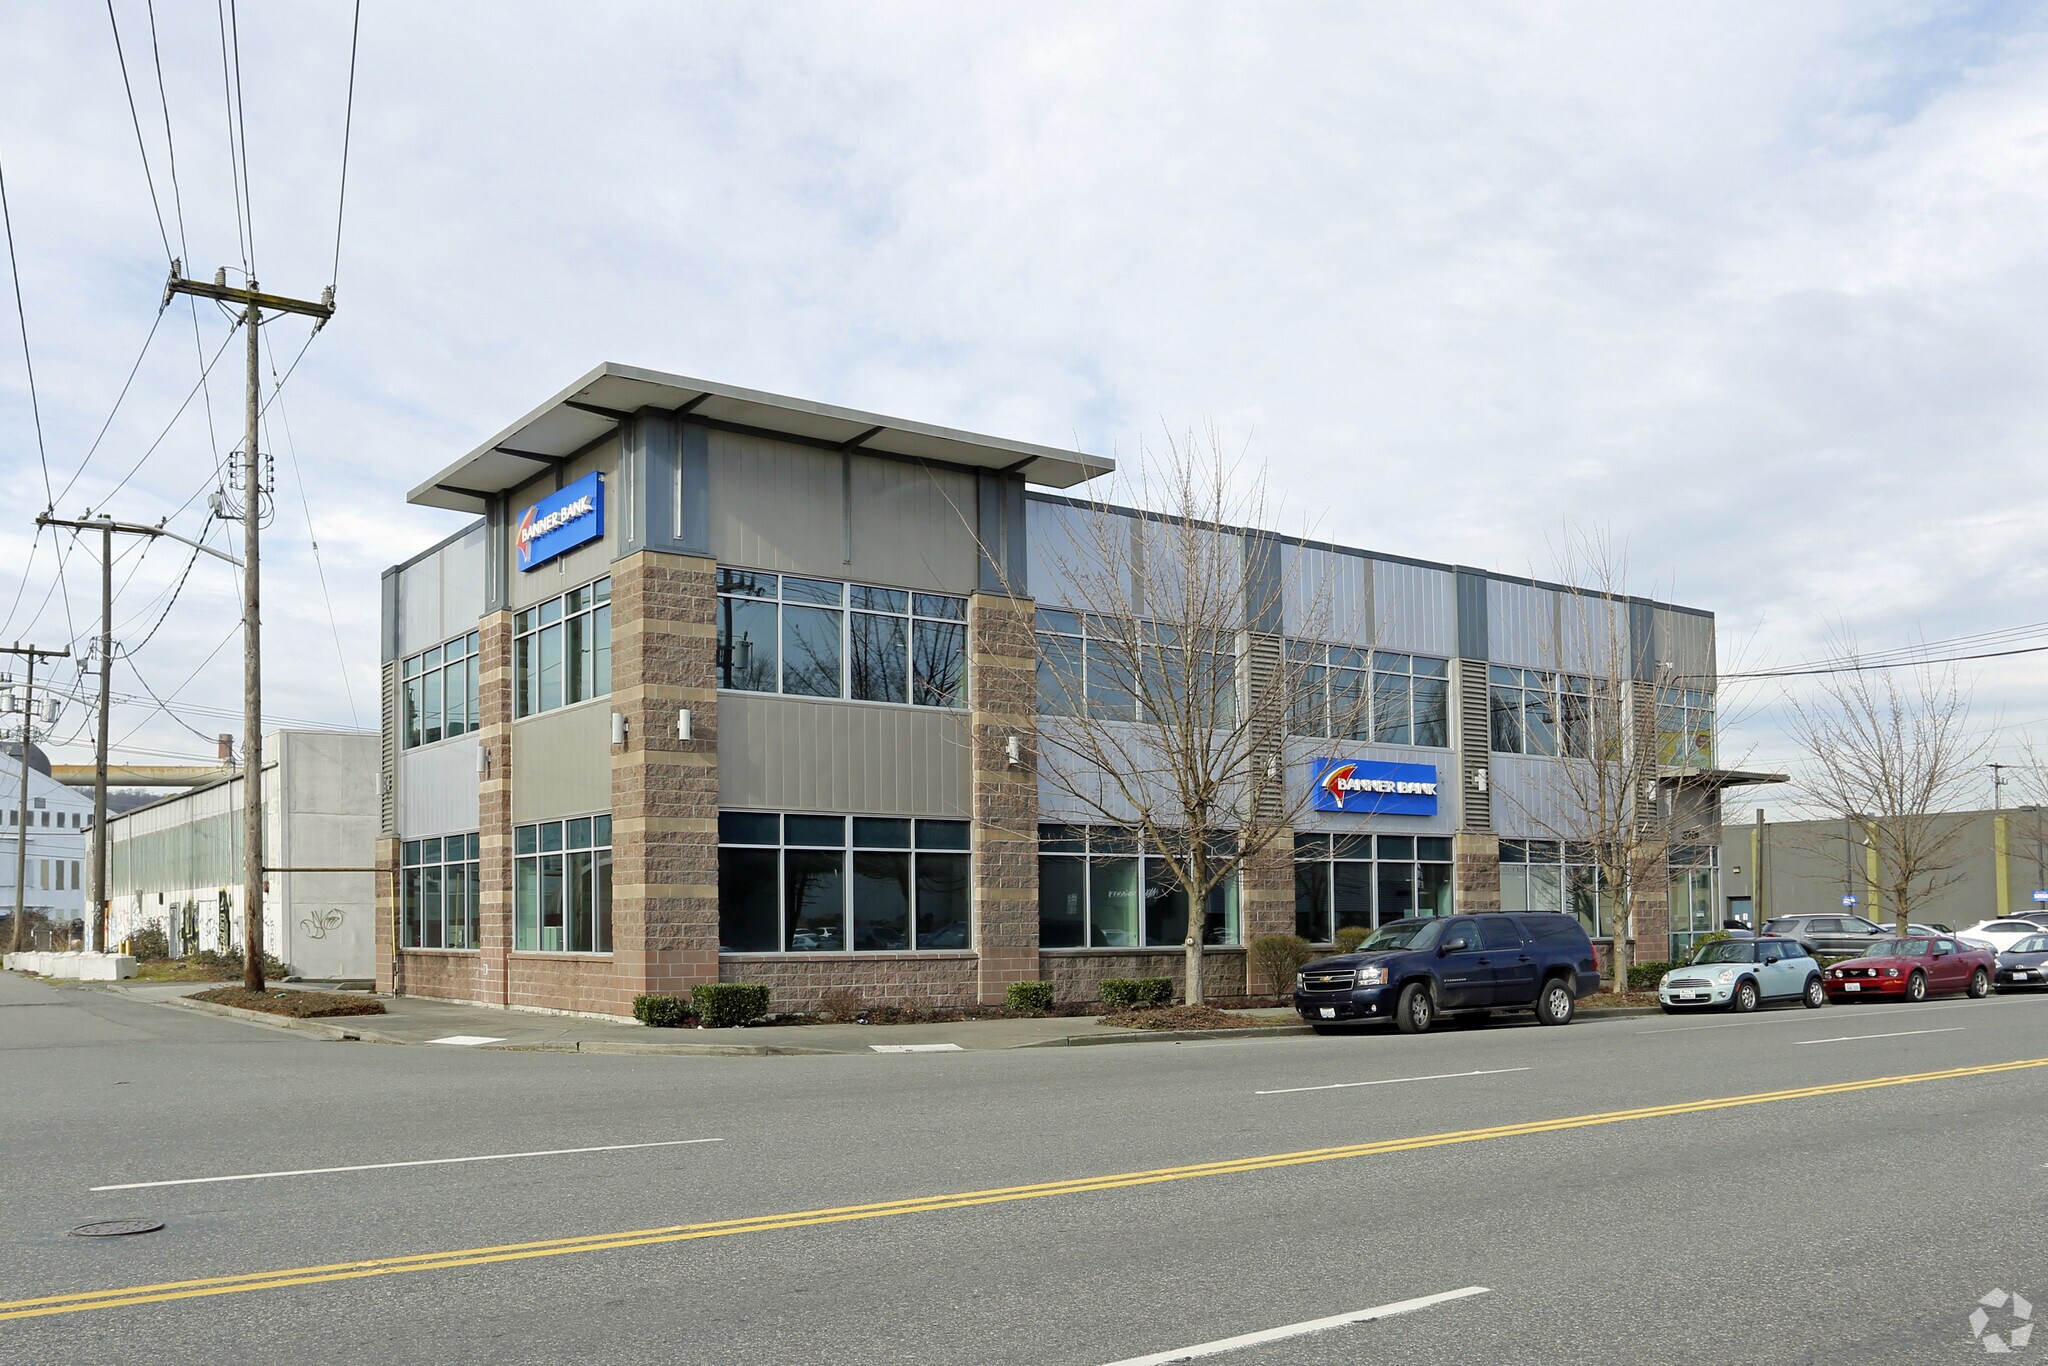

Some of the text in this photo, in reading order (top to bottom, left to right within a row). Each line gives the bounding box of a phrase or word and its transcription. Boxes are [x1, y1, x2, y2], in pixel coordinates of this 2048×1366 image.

[522, 495, 593, 542] BANNER BANK
[1337, 777, 1437, 795] BANNER BANK
